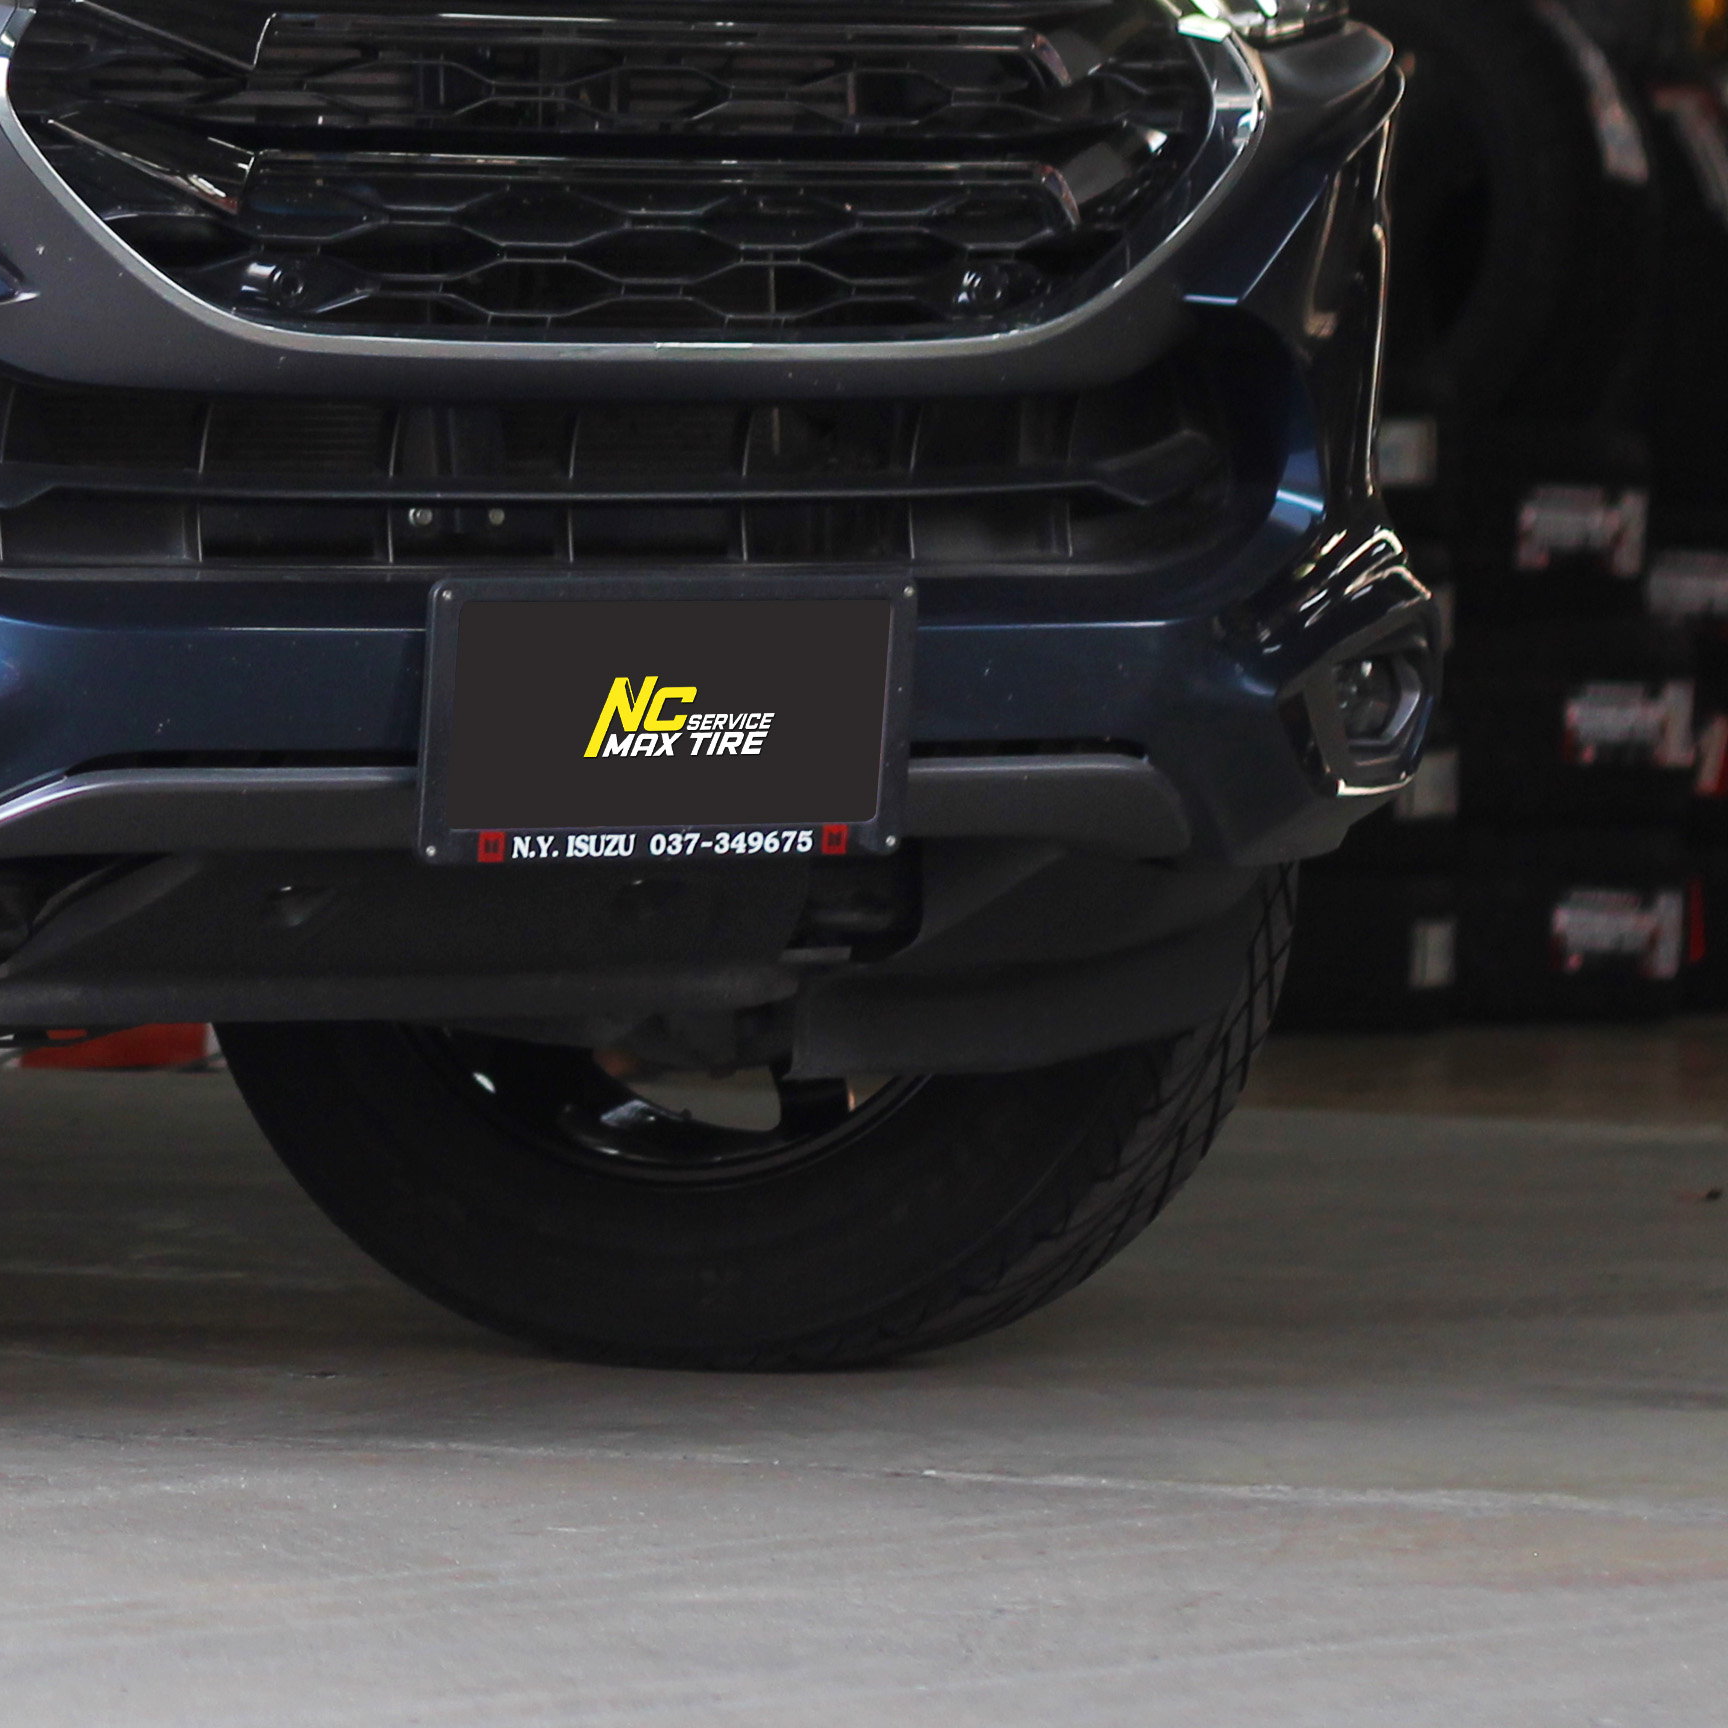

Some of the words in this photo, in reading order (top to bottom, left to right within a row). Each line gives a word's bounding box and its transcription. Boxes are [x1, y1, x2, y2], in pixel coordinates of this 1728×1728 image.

[511, 835, 559, 859] N.Y.
[566, 833, 637, 858] ISUZU
[649, 829, 814, 856] 037-349675
